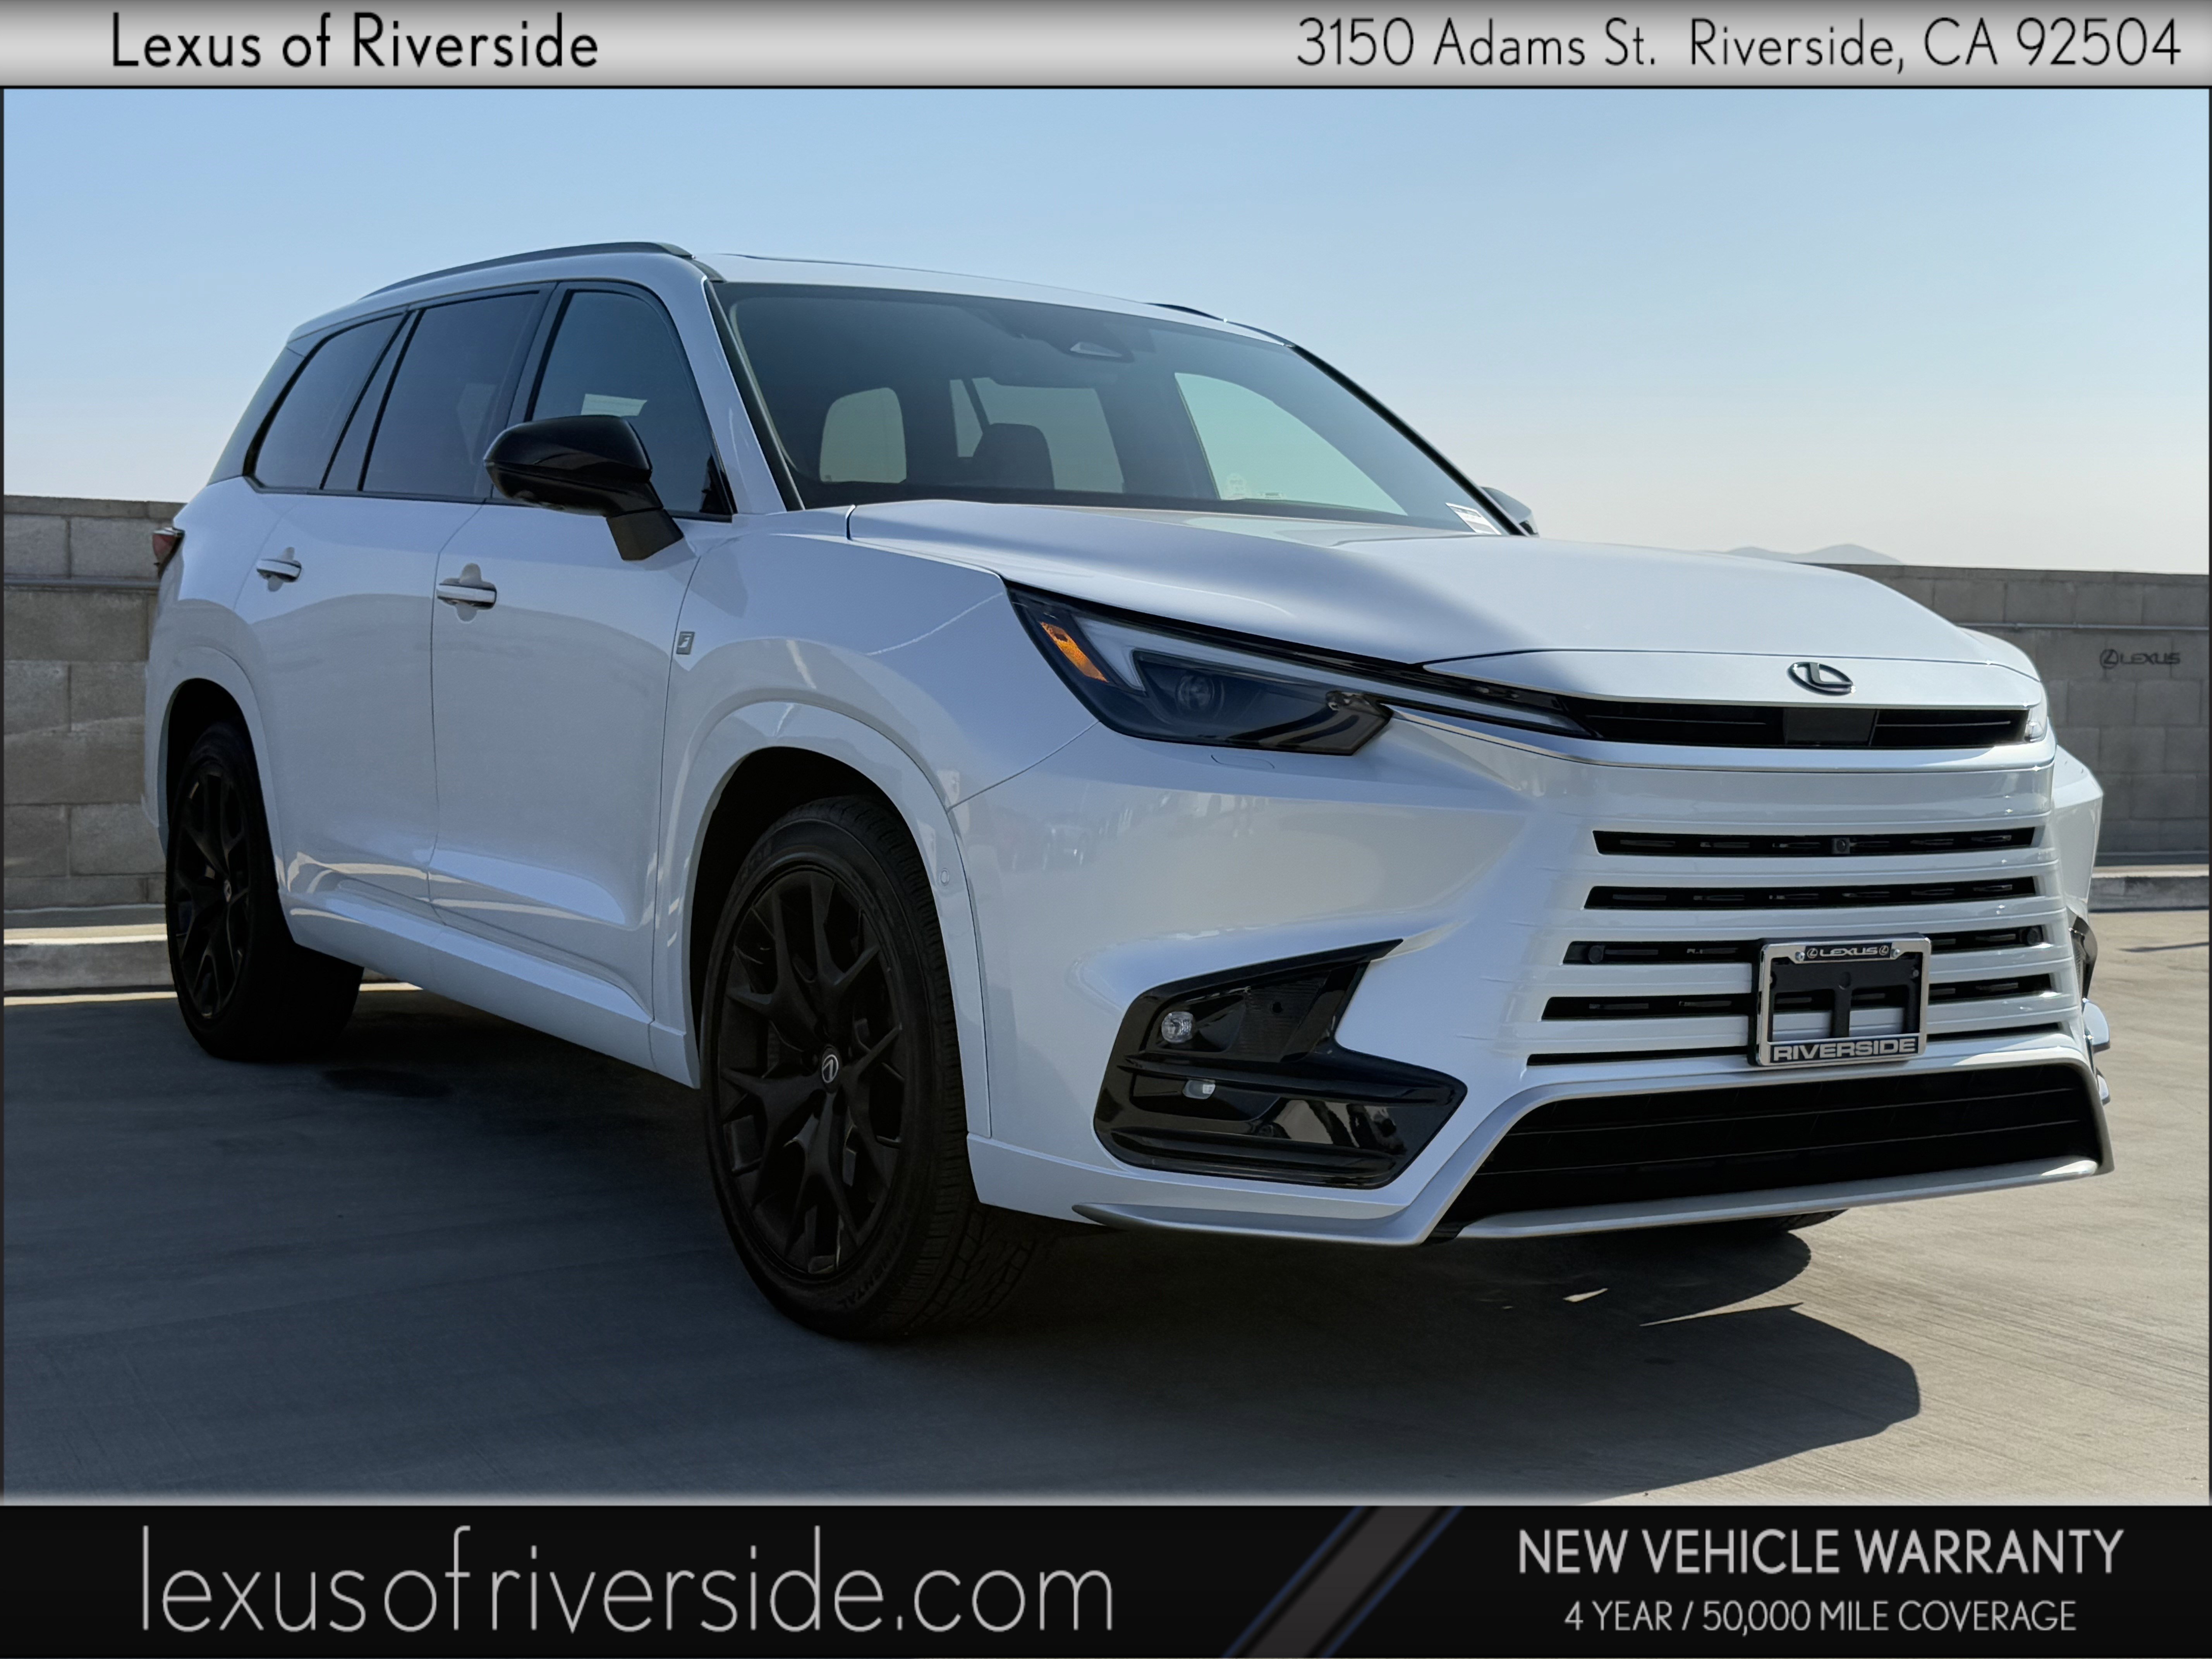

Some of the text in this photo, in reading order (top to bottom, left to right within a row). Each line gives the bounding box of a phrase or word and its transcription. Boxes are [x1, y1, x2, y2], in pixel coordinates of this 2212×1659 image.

[2120, 652, 2181, 665] LEXUS
[1820, 946, 1878, 957] LEXUS
[1773, 1038, 1916, 1061] RIVERSIDE
